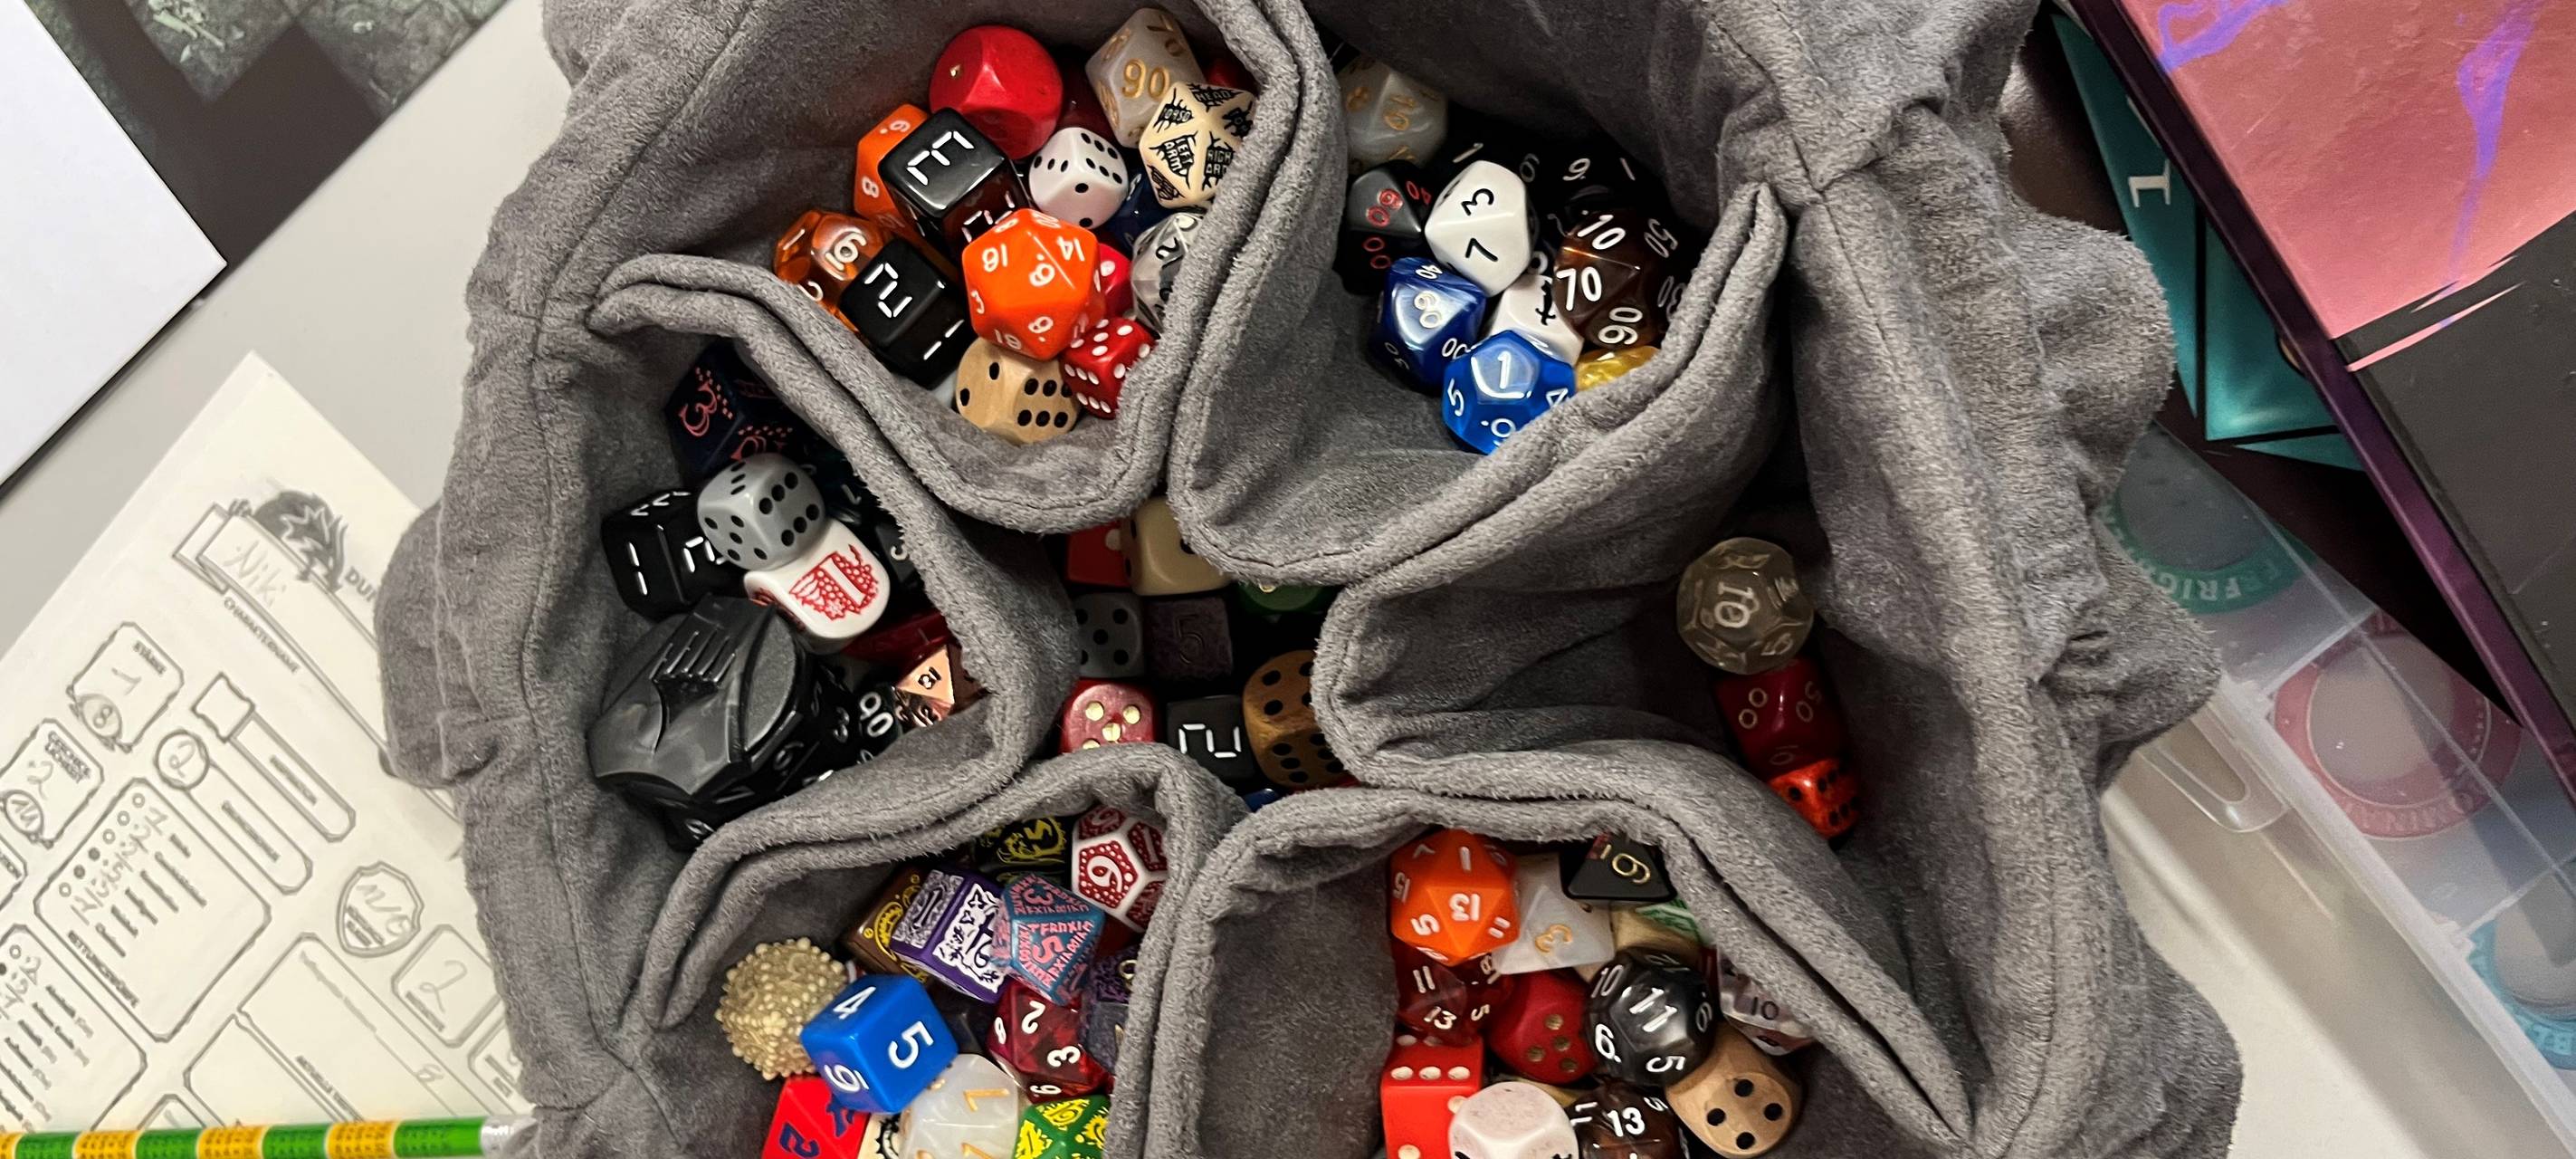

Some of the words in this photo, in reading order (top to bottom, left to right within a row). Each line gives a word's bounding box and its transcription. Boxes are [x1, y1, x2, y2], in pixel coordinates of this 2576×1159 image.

[1122, 59, 1169, 100] 90
[1164, 141, 1188, 175] ARM
[1176, 138, 1192, 165] LEFT
[1207, 148, 1233, 160] RIGH
[1461, 188, 1494, 216] 3
[1056, 235, 1084, 262] 14
[1577, 215, 1627, 250] 10
[1645, 218, 1678, 258] 50
[1465, 238, 1499, 262] 7
[864, 263, 912, 318] 2
[1557, 267, 1602, 311] 70
[923, 320, 965, 360] 1
[1497, 350, 1512, 389] 1
[1447, 378, 1465, 417] 5
[1714, 582, 1757, 628] 10
[859, 692, 894, 737] 90
[1449, 893, 1481, 922] 13
[1410, 914, 1440, 936] 5
[1535, 924, 1573, 953] 3
[1590, 964, 1625, 999] 10
[833, 986, 876, 1020] 4
[1022, 1001, 1045, 1034] 2
[1424, 1006, 1457, 1030] 13
[1471, 1004, 1490, 1021] 5
[1629, 987, 1677, 1032] 11
[1751, 996, 1779, 1020] 10
[888, 1020, 934, 1068] 5
[1047, 1045, 1082, 1068] 3
[1646, 1055, 1686, 1073] 5
[1608, 1106, 1646, 1137] 13
